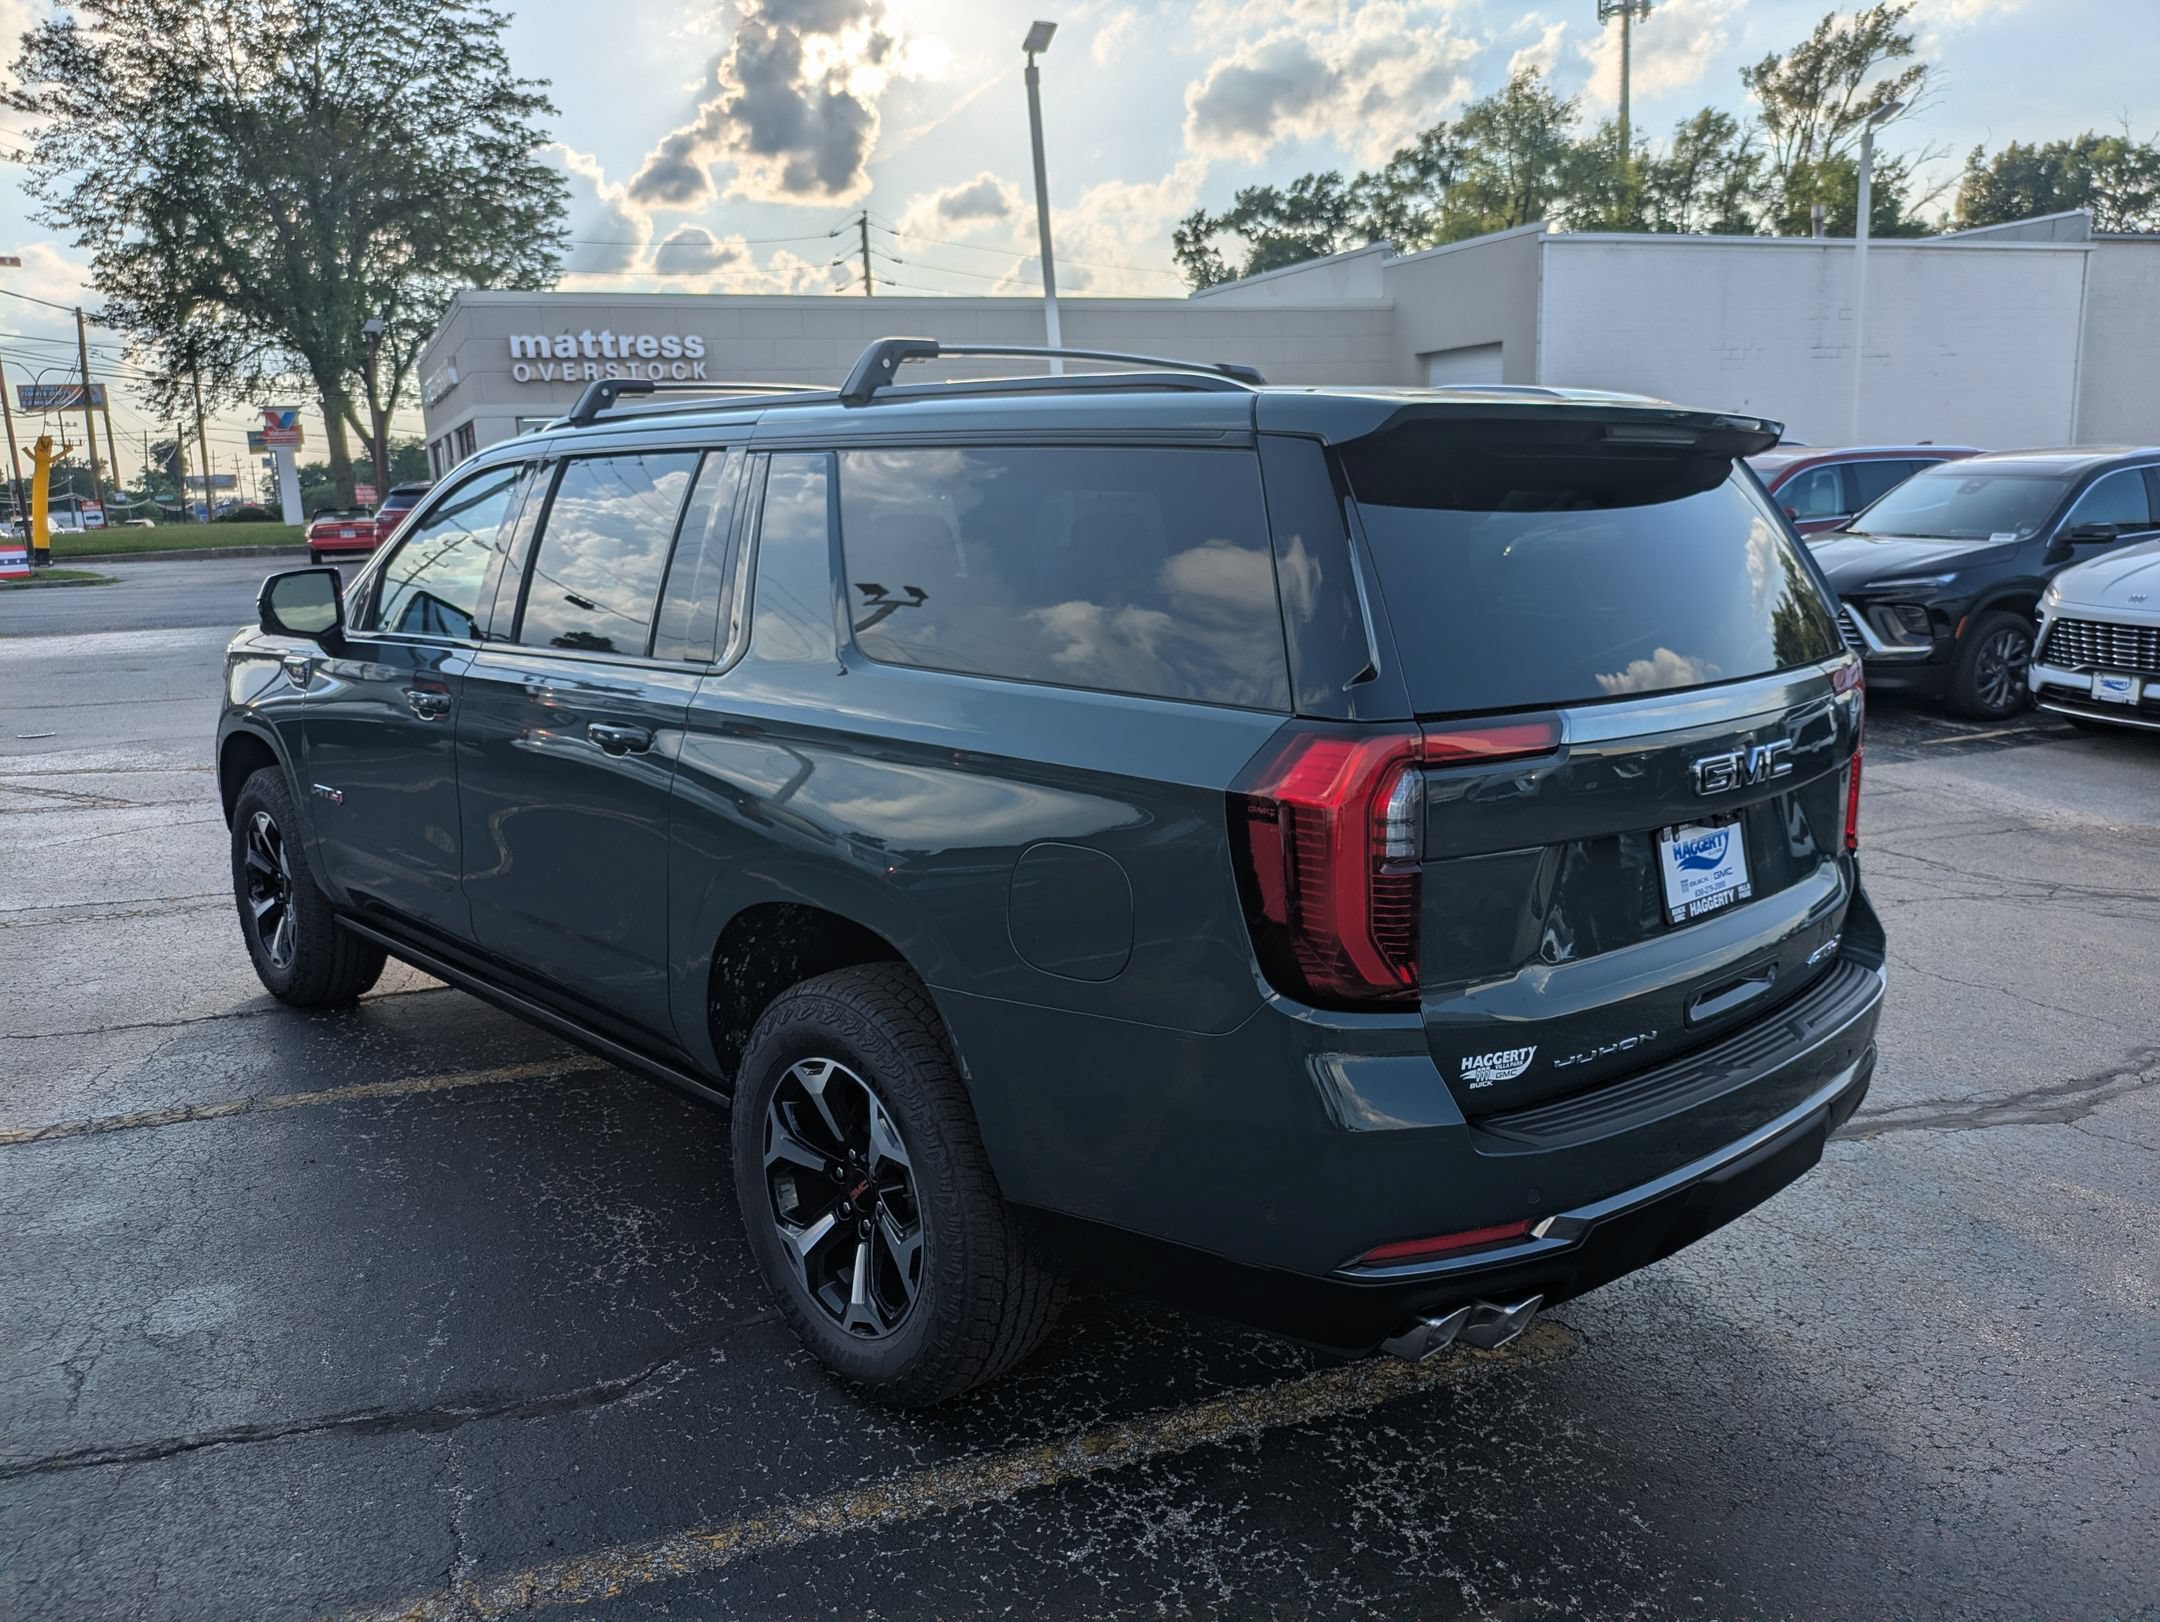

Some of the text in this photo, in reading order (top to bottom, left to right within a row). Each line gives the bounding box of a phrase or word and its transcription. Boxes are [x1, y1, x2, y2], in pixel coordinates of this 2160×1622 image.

[510, 329, 705, 358] mattress
[512, 361, 708, 382] OVERSTOCK
[1691, 738, 1793, 796] GMC
[1672, 828, 1729, 861] HAGGERTY
[1713, 866, 1734, 880] GMC
[1689, 888, 1735, 918] HAGGERTY
[1461, 1045, 1538, 1071] HAGGERTY
[1469, 1080, 1494, 1090] BUICK
[1495, 1070, 1518, 1079] GMC
